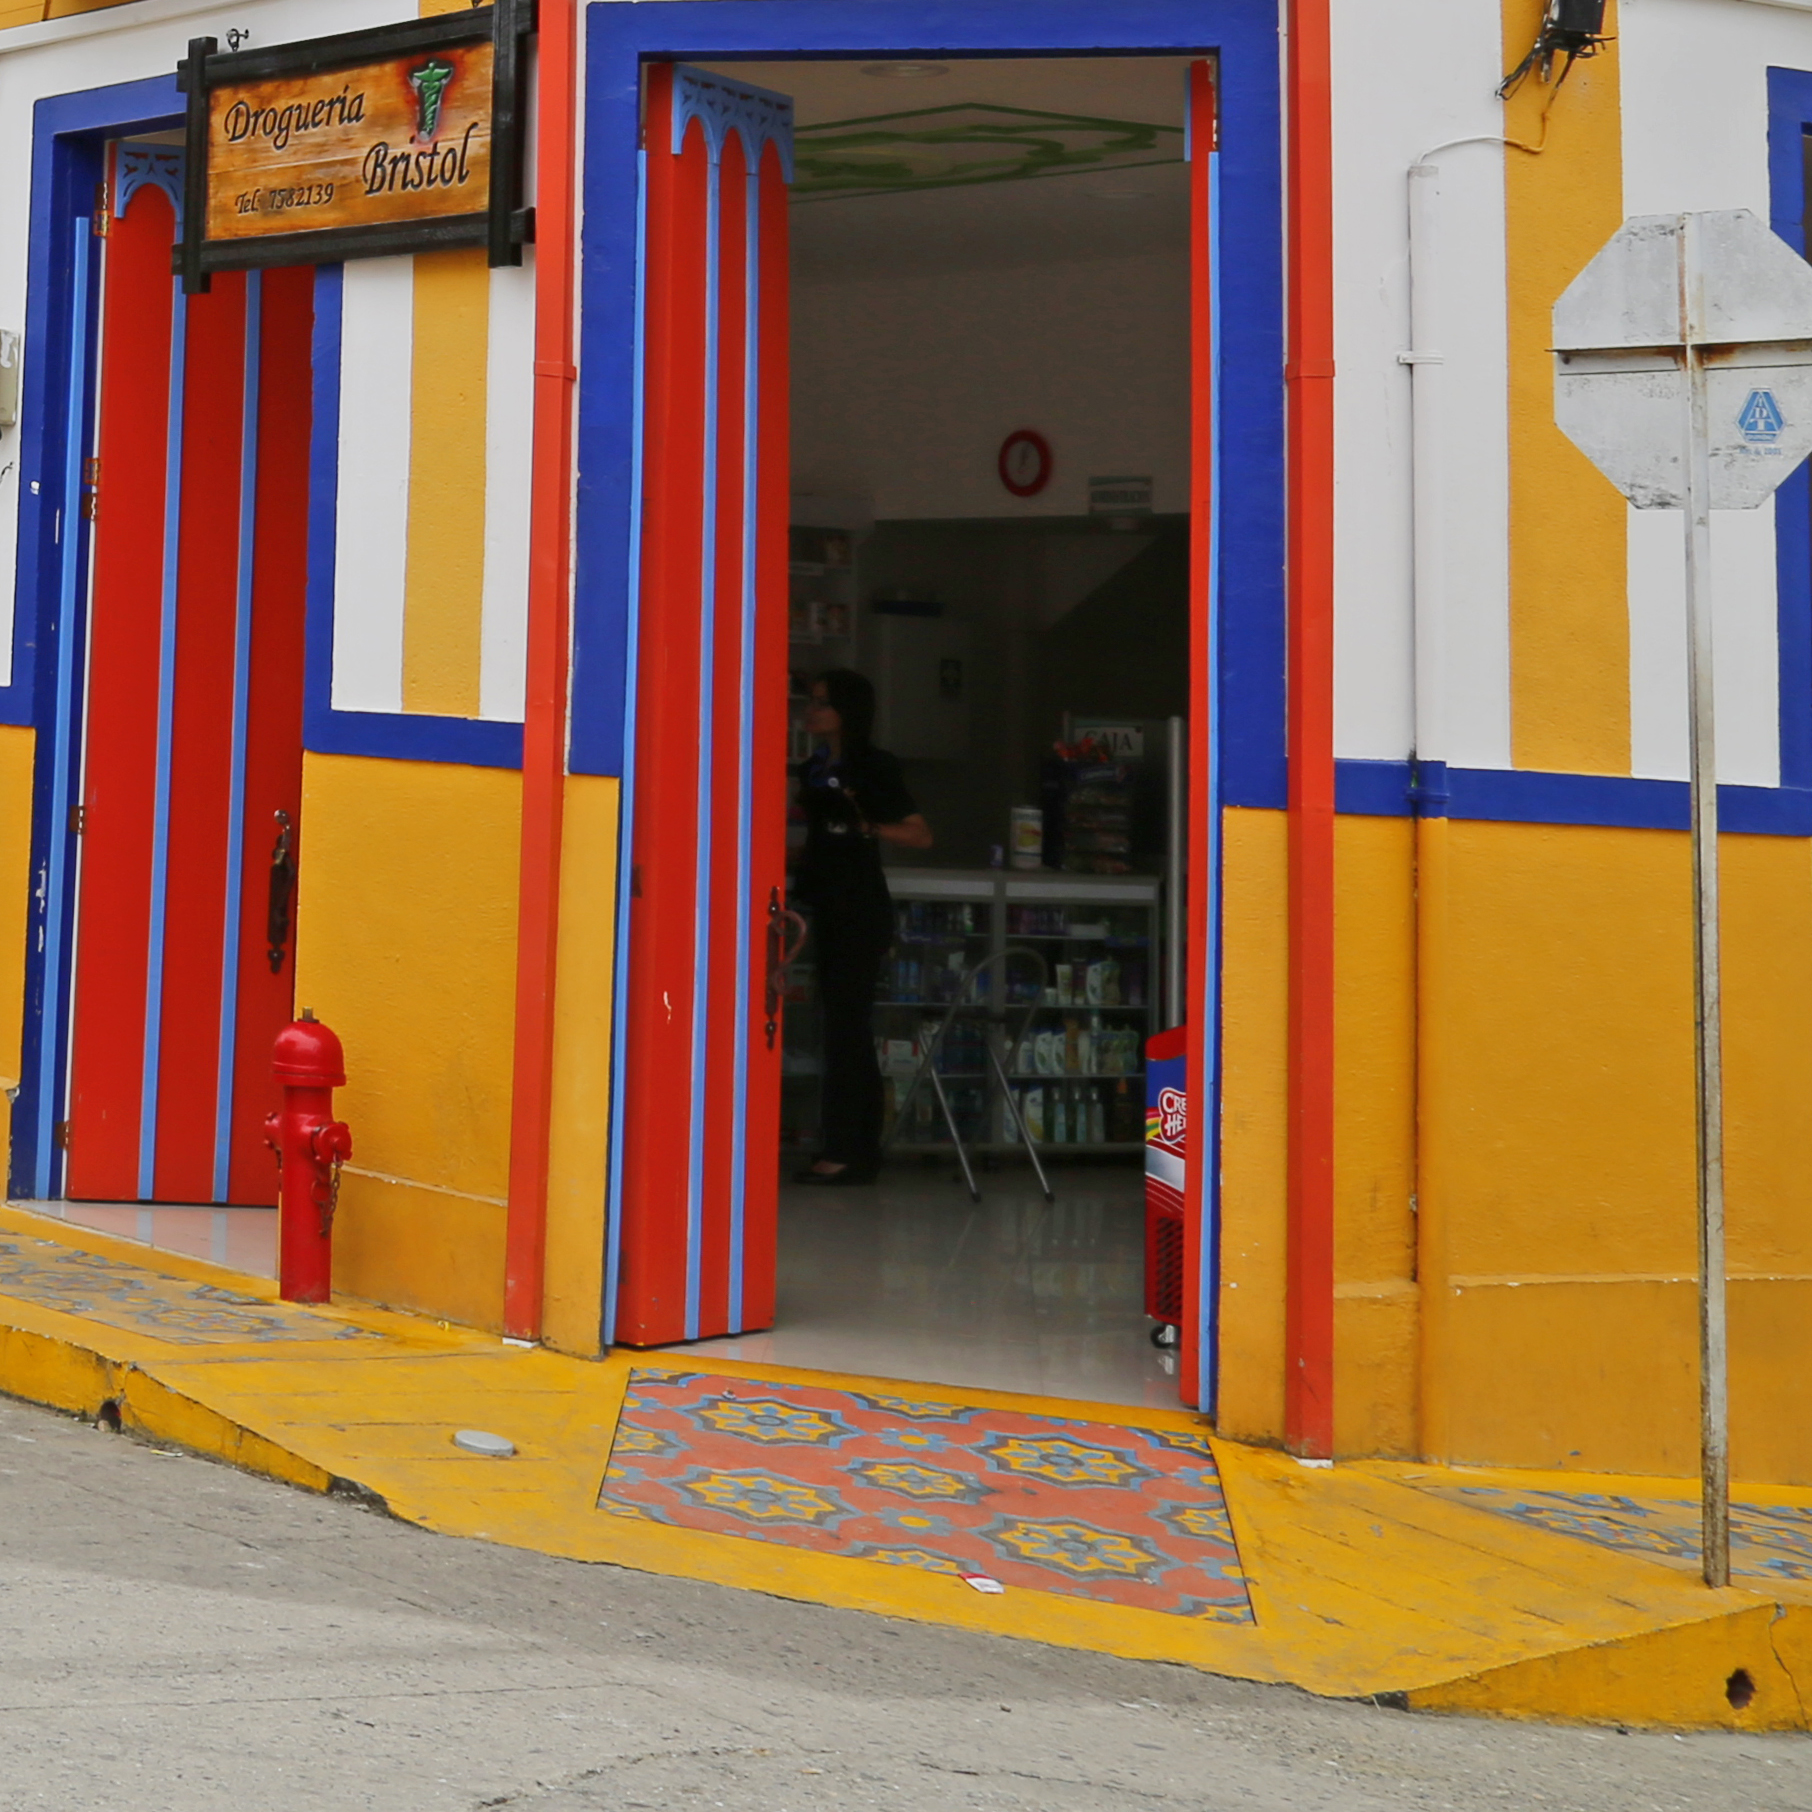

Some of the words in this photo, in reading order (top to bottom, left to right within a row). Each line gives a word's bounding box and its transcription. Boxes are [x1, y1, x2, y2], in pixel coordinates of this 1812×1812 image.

[223, 84, 366, 151] Droguería
[362, 122, 479, 196] Bristol
[269, 182, 335, 211] 7582139
